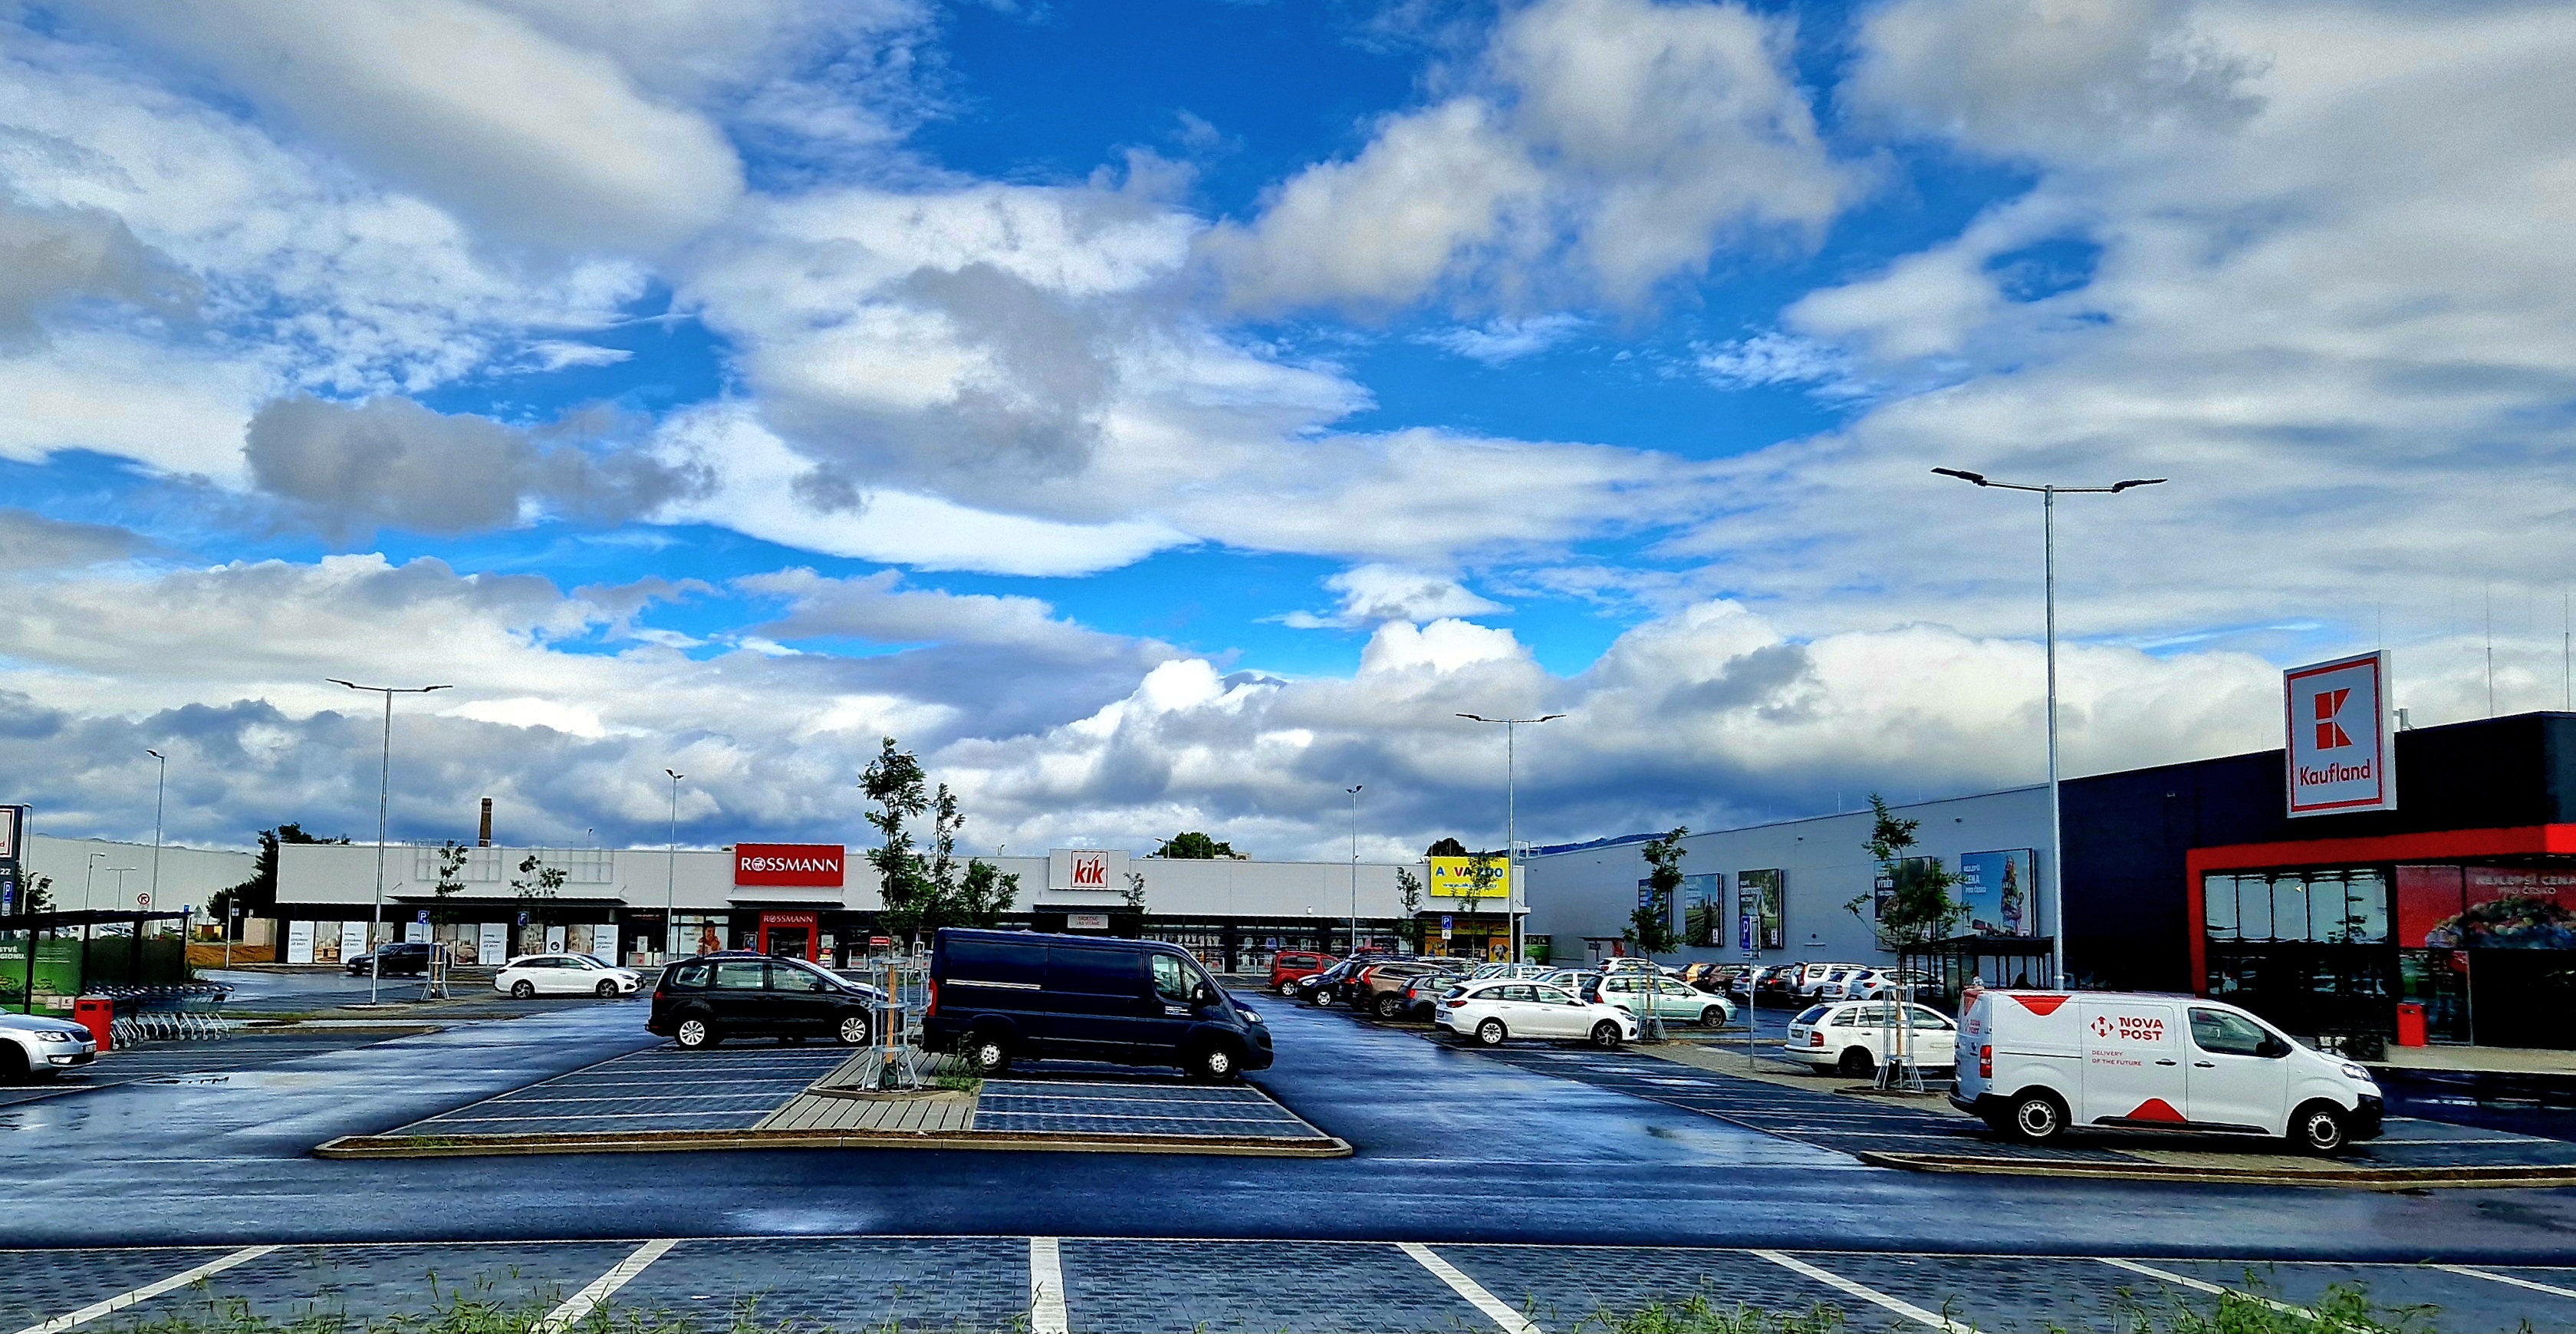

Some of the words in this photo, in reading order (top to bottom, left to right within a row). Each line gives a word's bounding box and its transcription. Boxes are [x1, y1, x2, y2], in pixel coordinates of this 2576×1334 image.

[2300, 758, 2371, 786] Kaufland
[741, 857, 839, 872] ROSSMANN
[1074, 854, 1106, 884] kik
[2119, 1017, 2164, 1029] NOVA
[2119, 1029, 2163, 1041] POST
